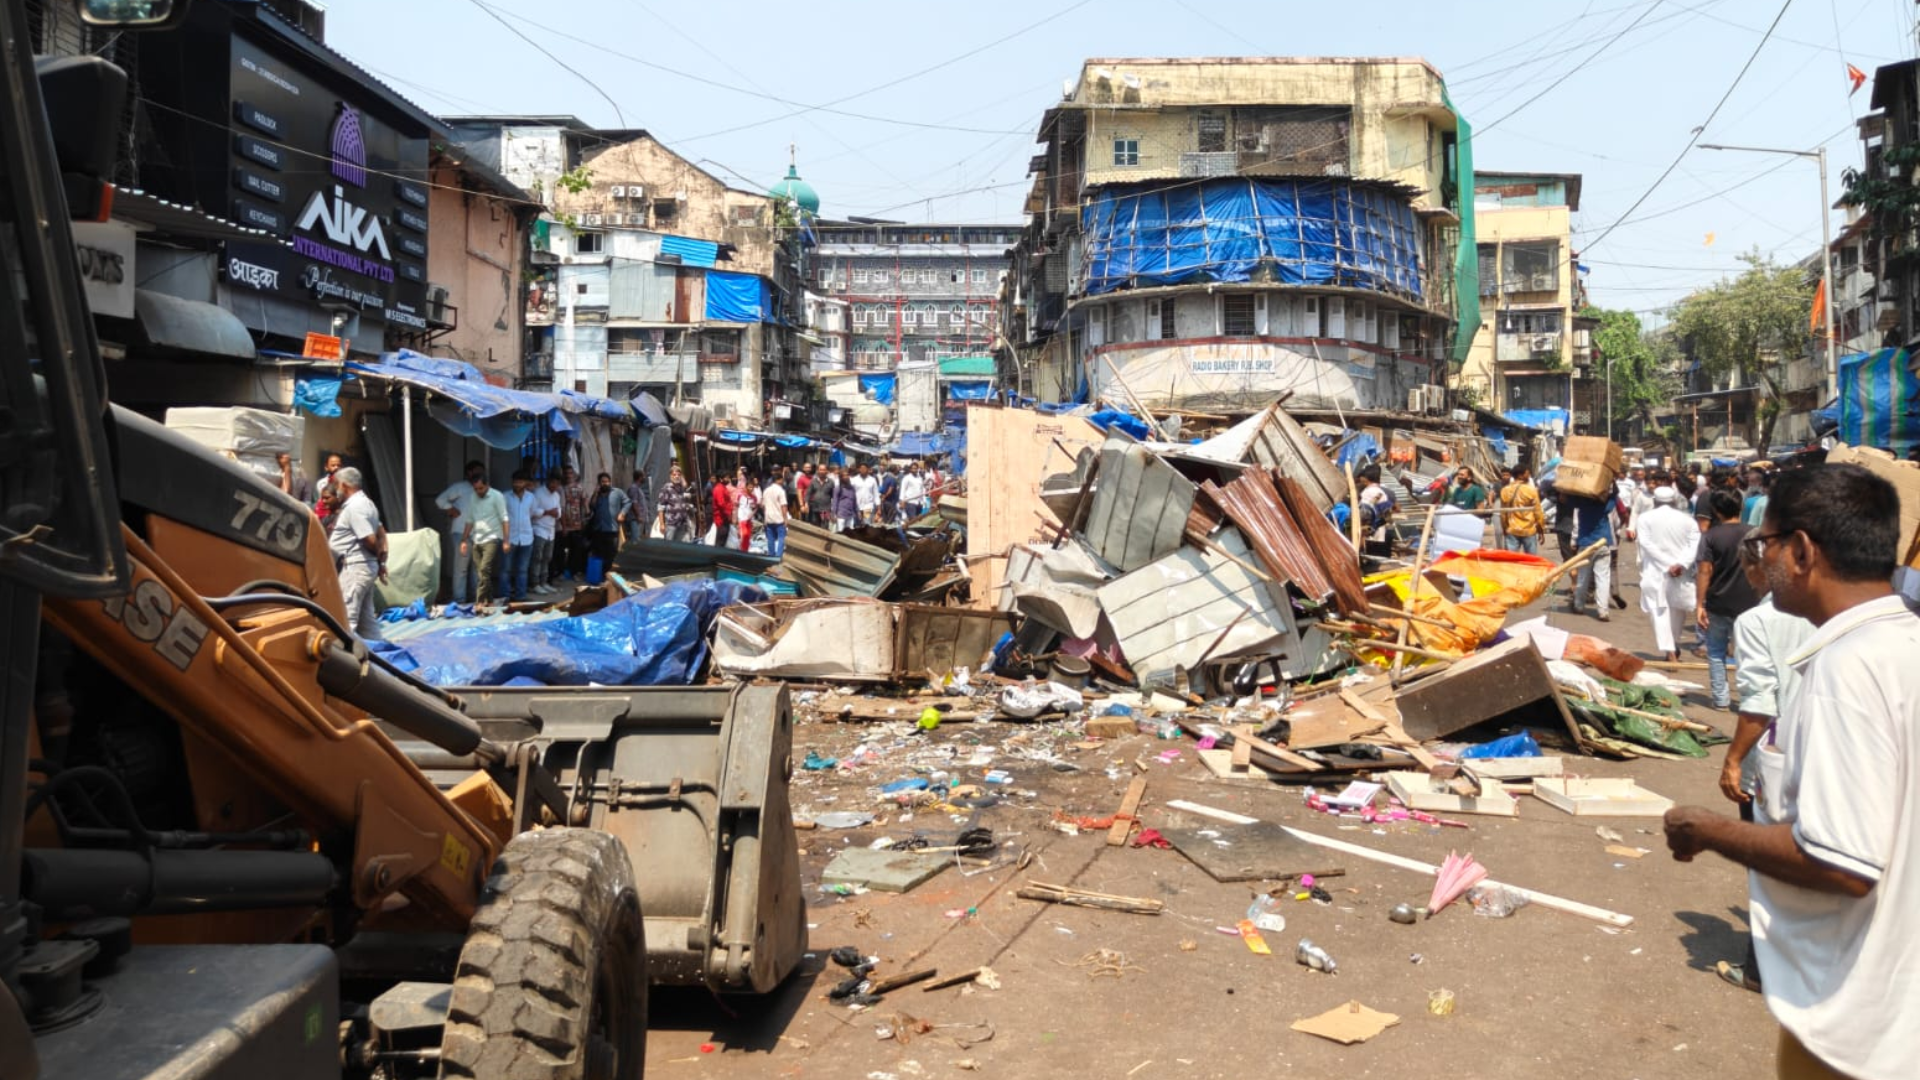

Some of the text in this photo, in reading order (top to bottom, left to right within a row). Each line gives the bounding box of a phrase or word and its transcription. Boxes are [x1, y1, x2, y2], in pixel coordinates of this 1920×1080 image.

[229, 257, 279, 290] आइका
[292, 234, 362, 273] INTERNATIONAL
[363, 260, 381, 279] PVT
[381, 266, 395, 284] LTD
[1192, 360, 1212, 371] RADIO
[1213, 360, 1240, 371] BAKERY
[1255, 359, 1272, 371] SHOP
[231, 489, 304, 551] 770
